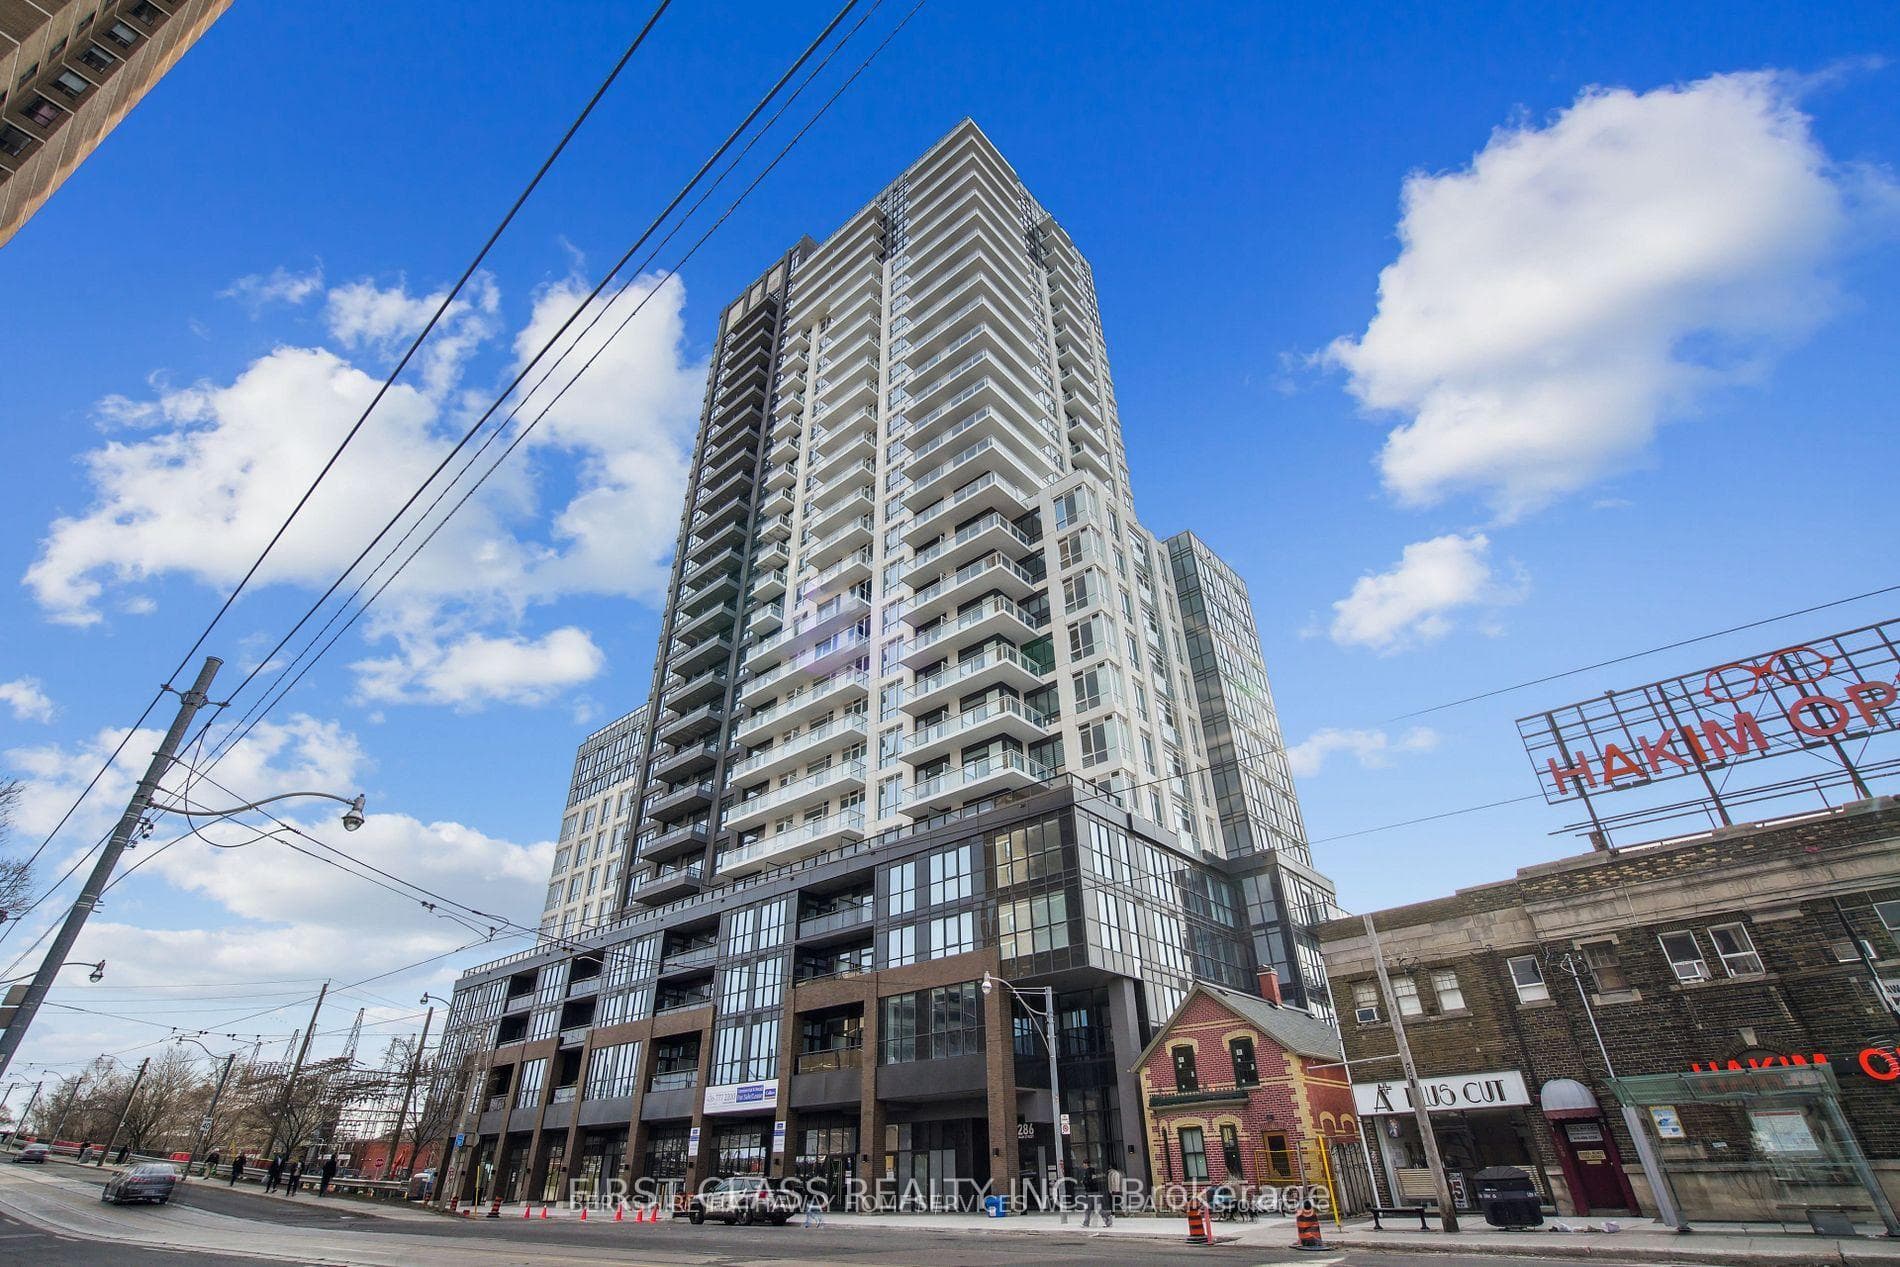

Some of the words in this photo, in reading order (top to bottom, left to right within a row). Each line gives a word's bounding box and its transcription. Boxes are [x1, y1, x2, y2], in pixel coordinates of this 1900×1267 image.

[1548, 712, 1770, 795] HAKIM
[1789, 672, 1900, 736] OP
[1858, 1047, 1900, 1081] O
[1463, 1079, 1506, 1103] CUT
[1017, 1123, 1035, 1136] 286
